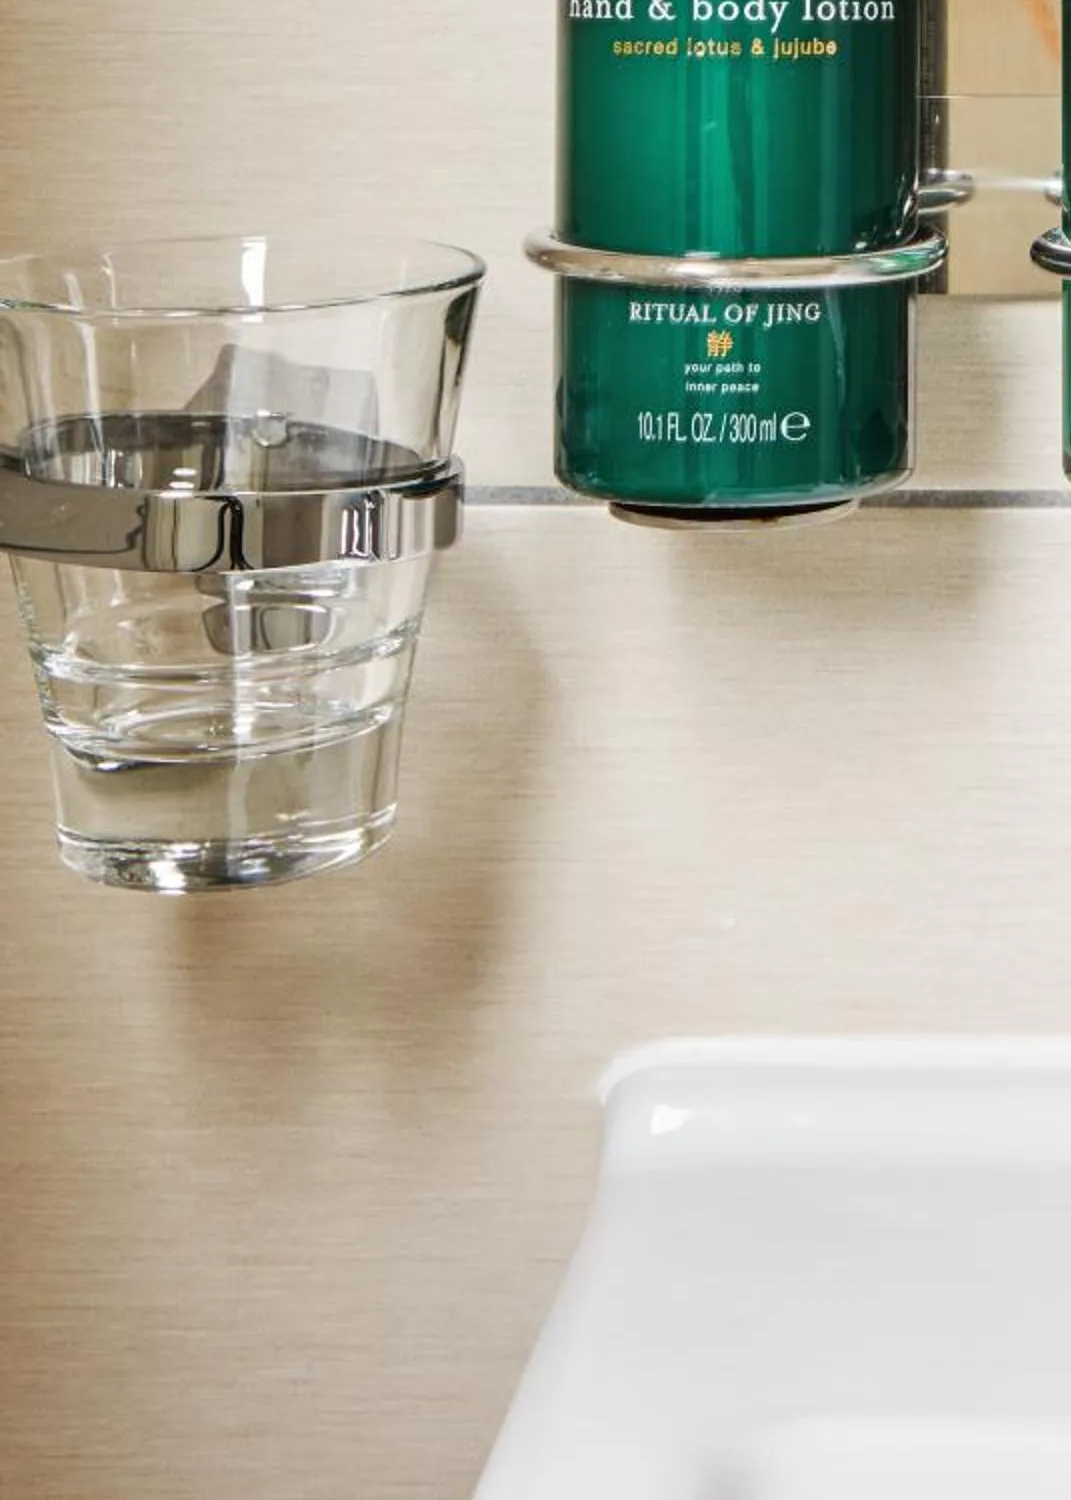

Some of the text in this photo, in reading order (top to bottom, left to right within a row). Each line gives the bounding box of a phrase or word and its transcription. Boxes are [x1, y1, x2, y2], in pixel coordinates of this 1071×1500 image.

[612, 37, 838, 60] sacred lotus & jujube
[628, 301, 822, 329] RITUAL OF JING
[684, 361, 761, 375] your path to
[685, 381, 760, 395] inner peace
[637, 411, 663, 441] 10.1
